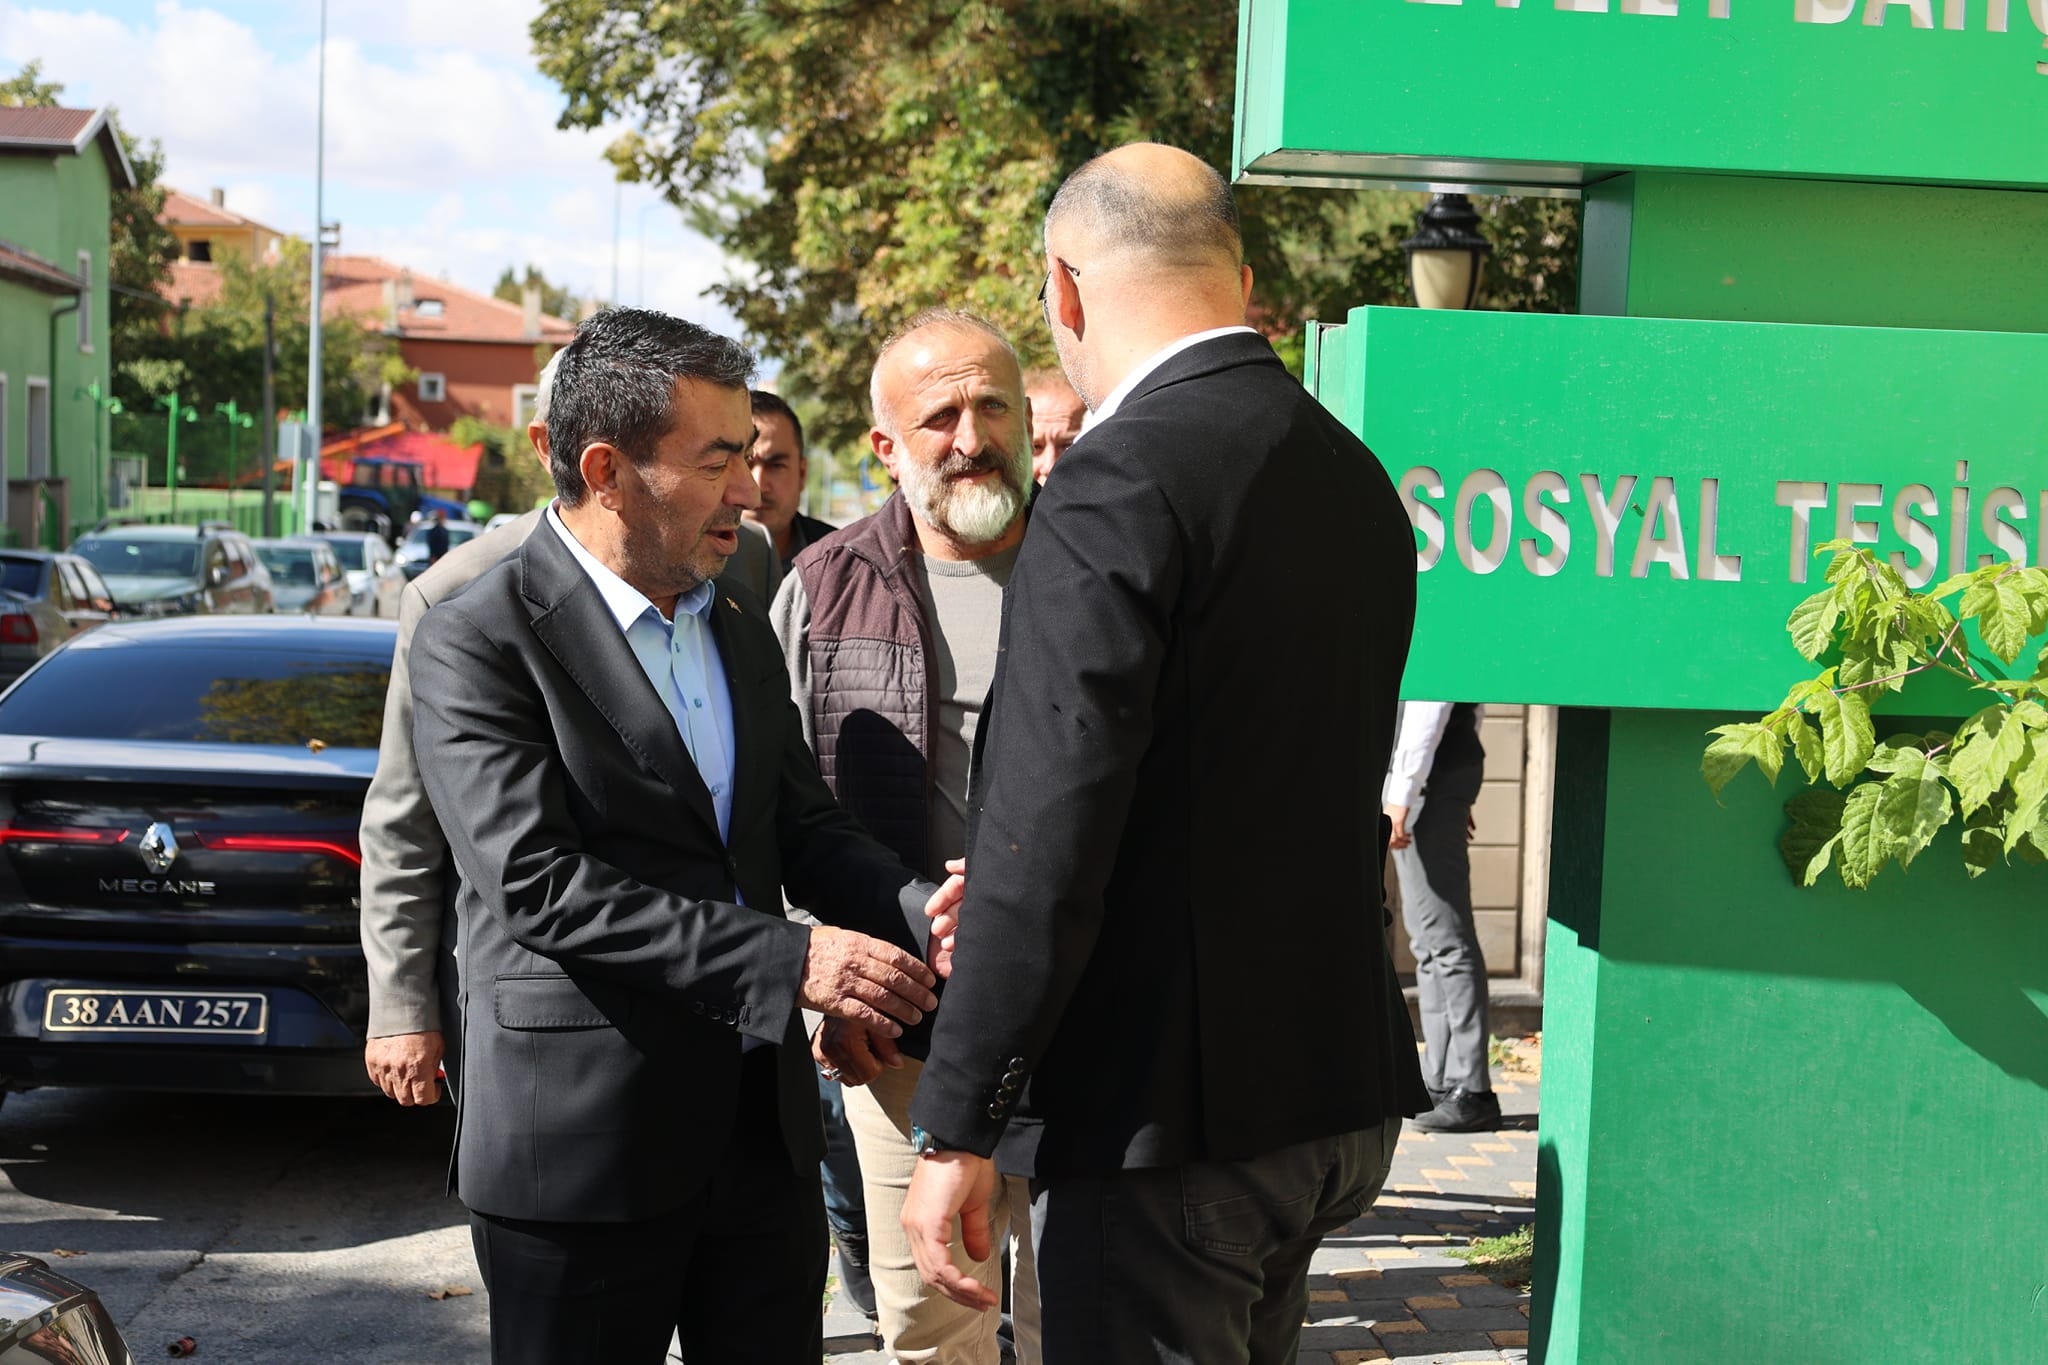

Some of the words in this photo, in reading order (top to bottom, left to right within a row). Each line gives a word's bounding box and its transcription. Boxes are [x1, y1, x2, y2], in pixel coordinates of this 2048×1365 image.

[1398, 466, 1742, 582] SOSYAL
[1774, 460, 2048, 588] TESİS
[99, 878, 216, 896] MEGANE
[61, 997, 99, 1024] 38
[105, 999, 184, 1025] AAN
[193, 1000, 249, 1027] 257
